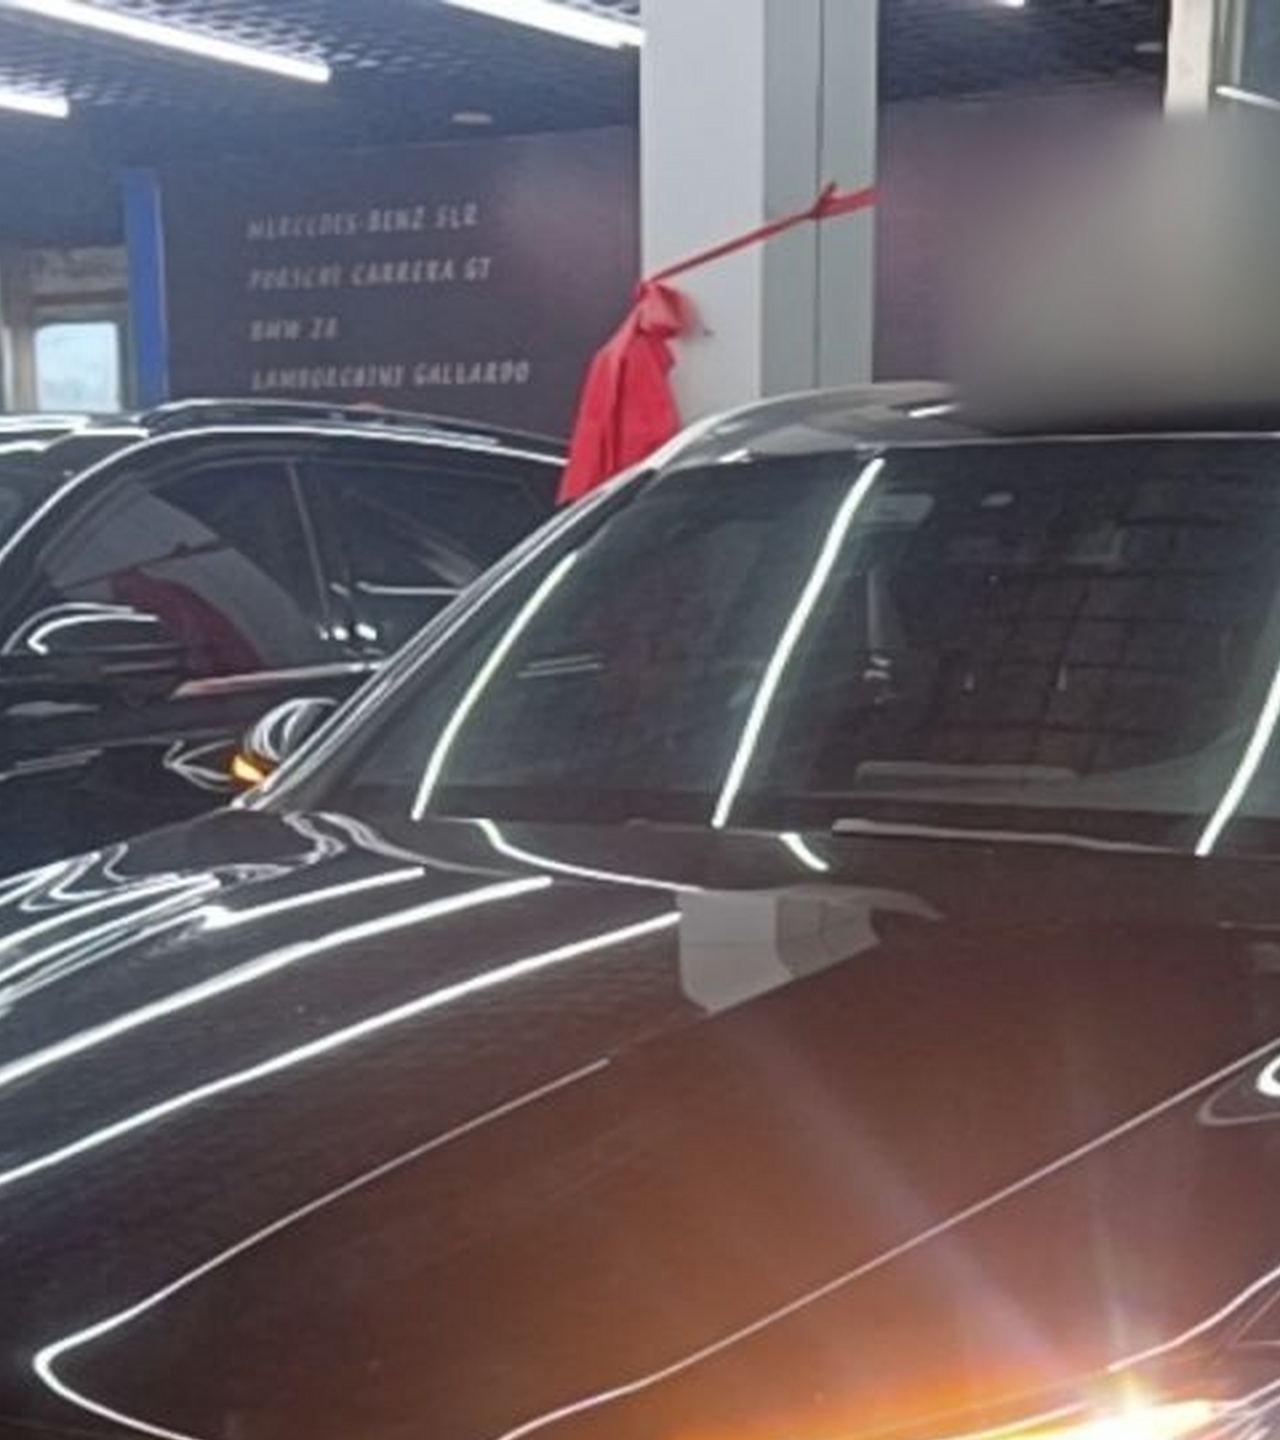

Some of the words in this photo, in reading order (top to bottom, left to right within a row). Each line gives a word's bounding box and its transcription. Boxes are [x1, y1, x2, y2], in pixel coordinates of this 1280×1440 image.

[350, 257, 454, 287] CARRERA
[250, 319, 301, 342] BMW
[413, 358, 529, 386] GALLARDO
